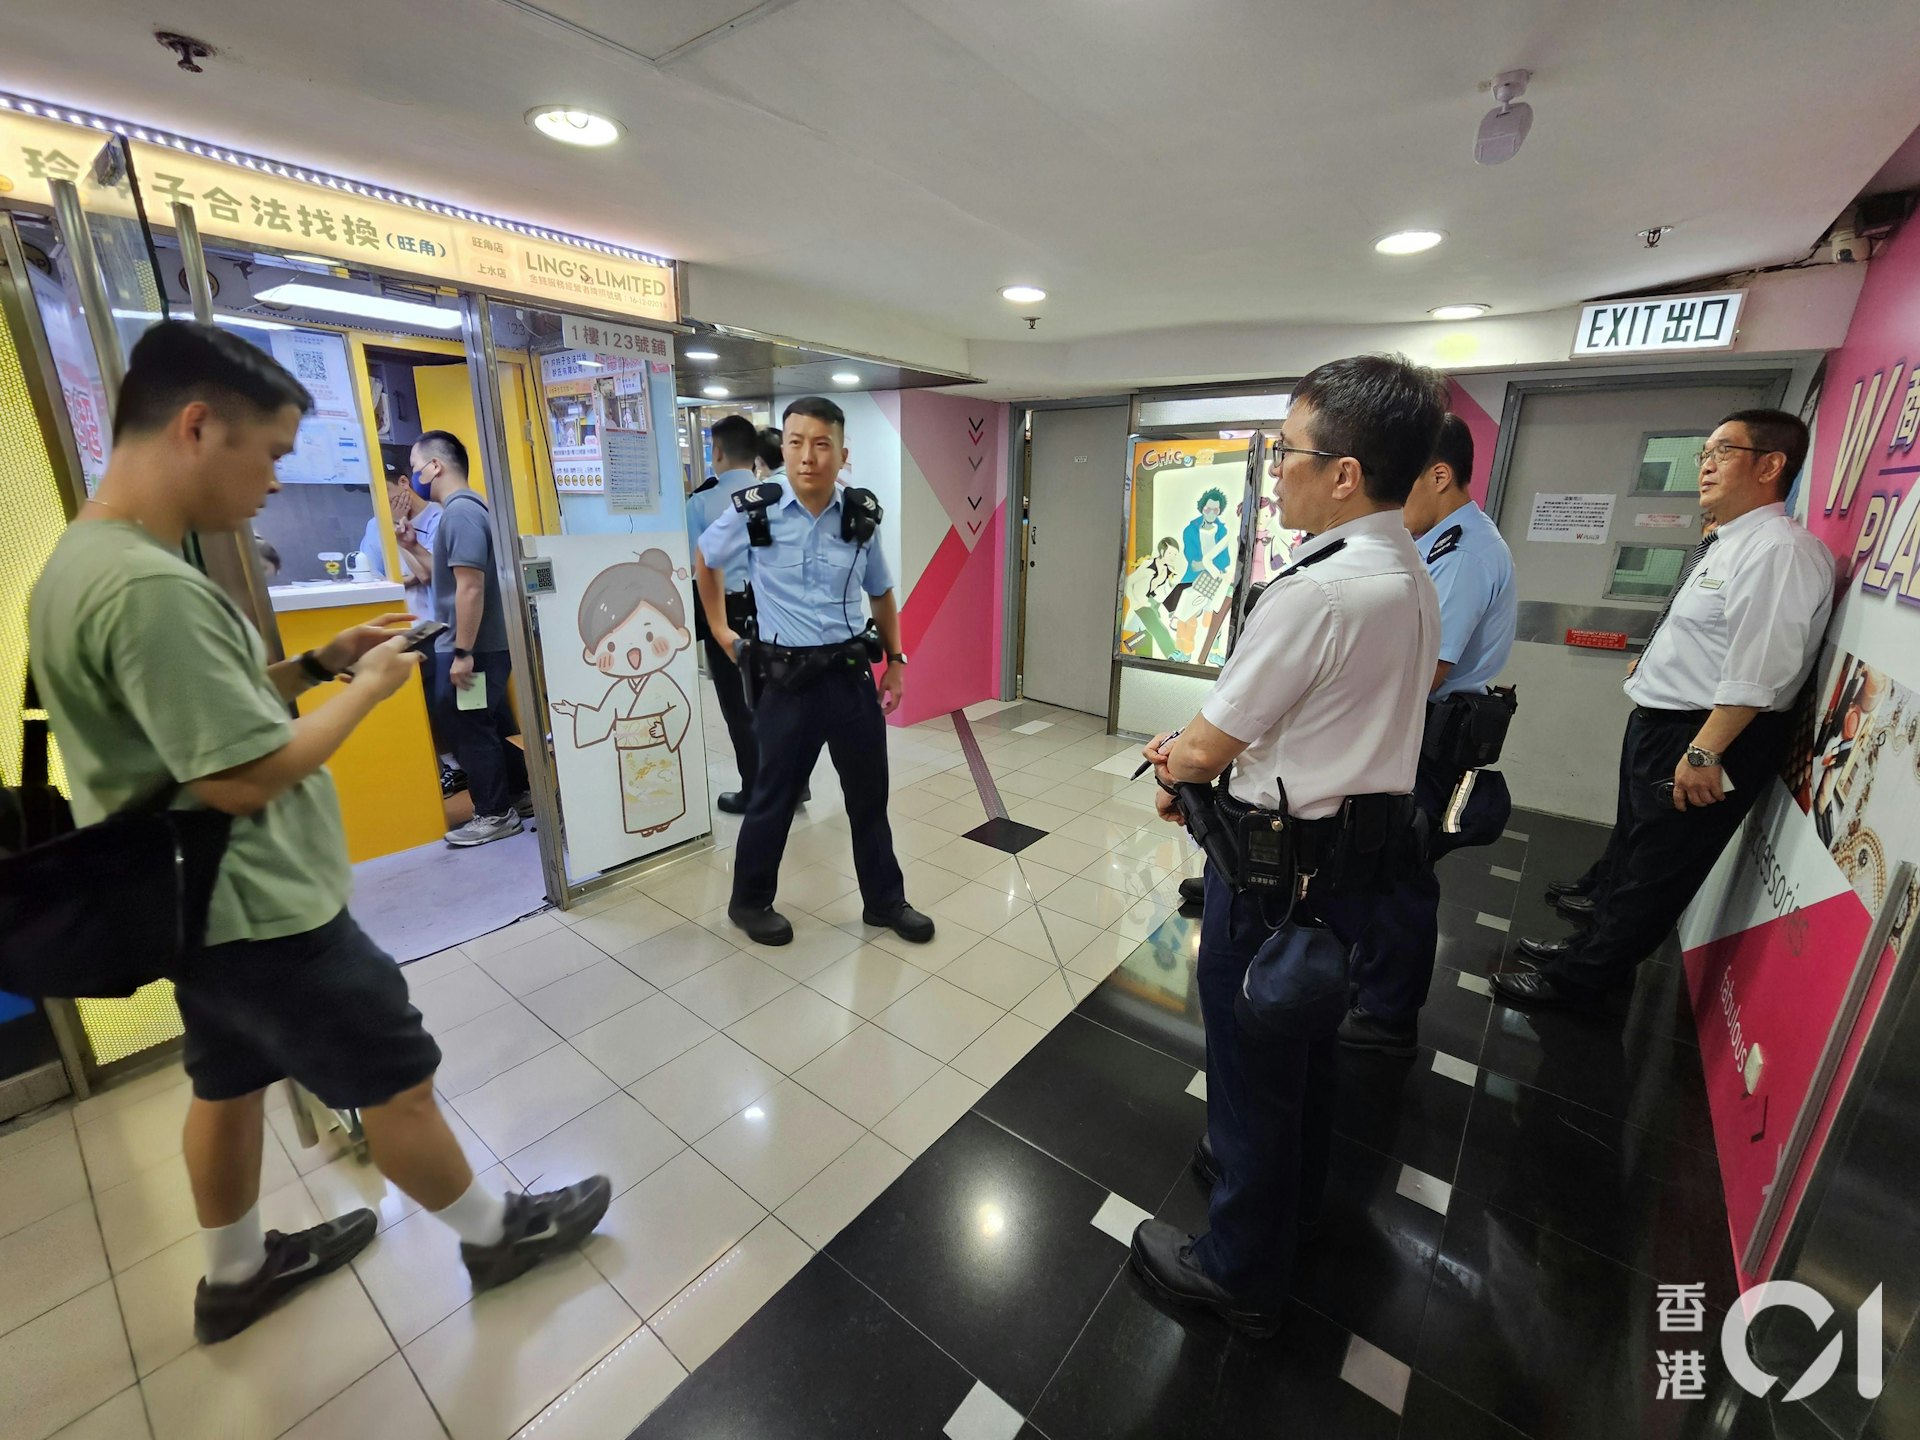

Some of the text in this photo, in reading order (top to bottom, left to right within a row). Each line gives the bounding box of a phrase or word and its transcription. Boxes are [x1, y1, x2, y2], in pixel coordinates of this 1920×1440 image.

[21, 146, 381, 250] 玲子合法找換
[471, 236, 504, 254] 旺角店
[477, 263, 507, 280] 上水店
[525, 251, 666, 297] LING'S LIMITED
[1586, 298, 1730, 348] EXIT 出口
[1824, 362, 1905, 515] W
[1719, 965, 1748, 1073] fabulous
